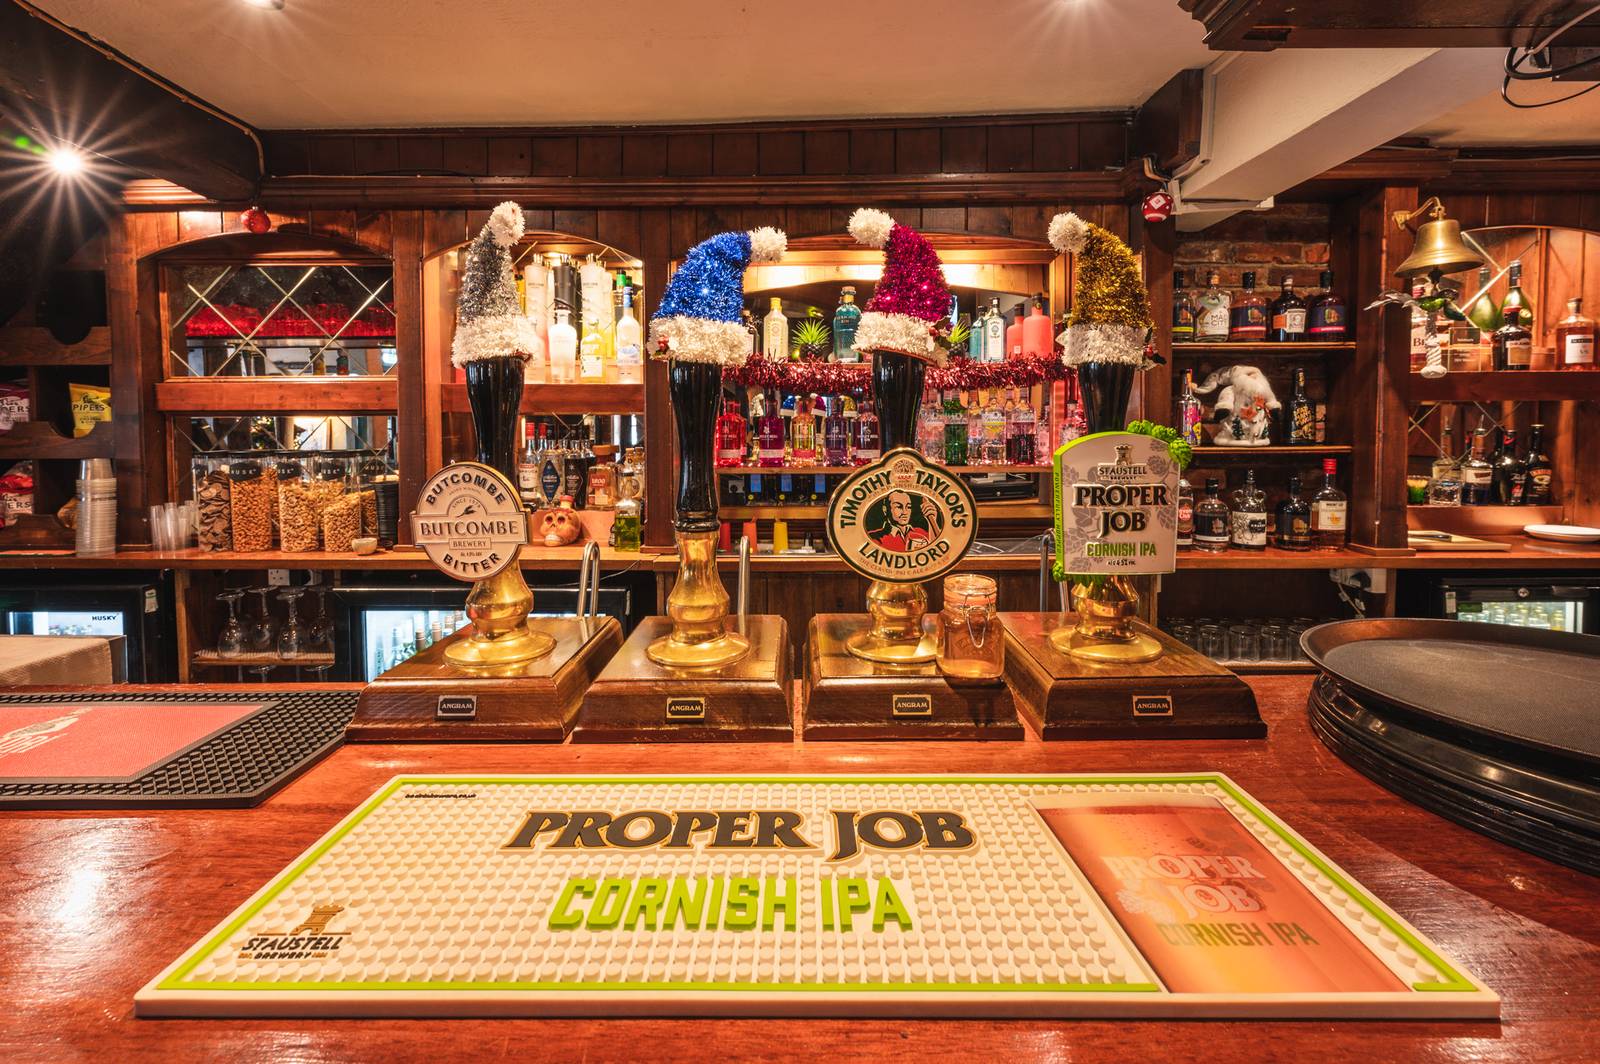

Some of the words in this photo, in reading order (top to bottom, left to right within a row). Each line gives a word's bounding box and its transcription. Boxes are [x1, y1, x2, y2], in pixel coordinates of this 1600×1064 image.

[425, 472, 507, 506] BUTCOMBE
[840, 469, 892, 528] TIMOTHY
[915, 469, 969, 528] TAYLOR'S
[1073, 484, 1169, 507] PROPER
[420, 520, 519, 537] BUTCOMBE
[1099, 511, 1147, 538] JOB
[452, 540, 487, 548] BREWERY
[858, 540, 951, 569] LANDLORD
[1086, 542, 1136, 557] CORNISH
[1139, 542, 1157, 556] IPA
[443, 552, 502, 573] BITTER
[441, 702, 473, 710] ANGRAM
[669, 704, 701, 712] ANGRAM
[896, 701, 928, 709] ANGRAM
[1136, 701, 1169, 710] ANGRAM
[501, 808, 815, 849] PROPER
[826, 808, 976, 862] JOB
[1102, 854, 1266, 879] PROPER
[548, 877, 797, 931] CORNISH
[820, 877, 913, 931] IPA
[1171, 883, 1266, 920] JOB
[1157, 922, 1271, 947] CORNISH
[1267, 922, 1320, 947] IPA
[253, 951, 312, 960] BREWERY
